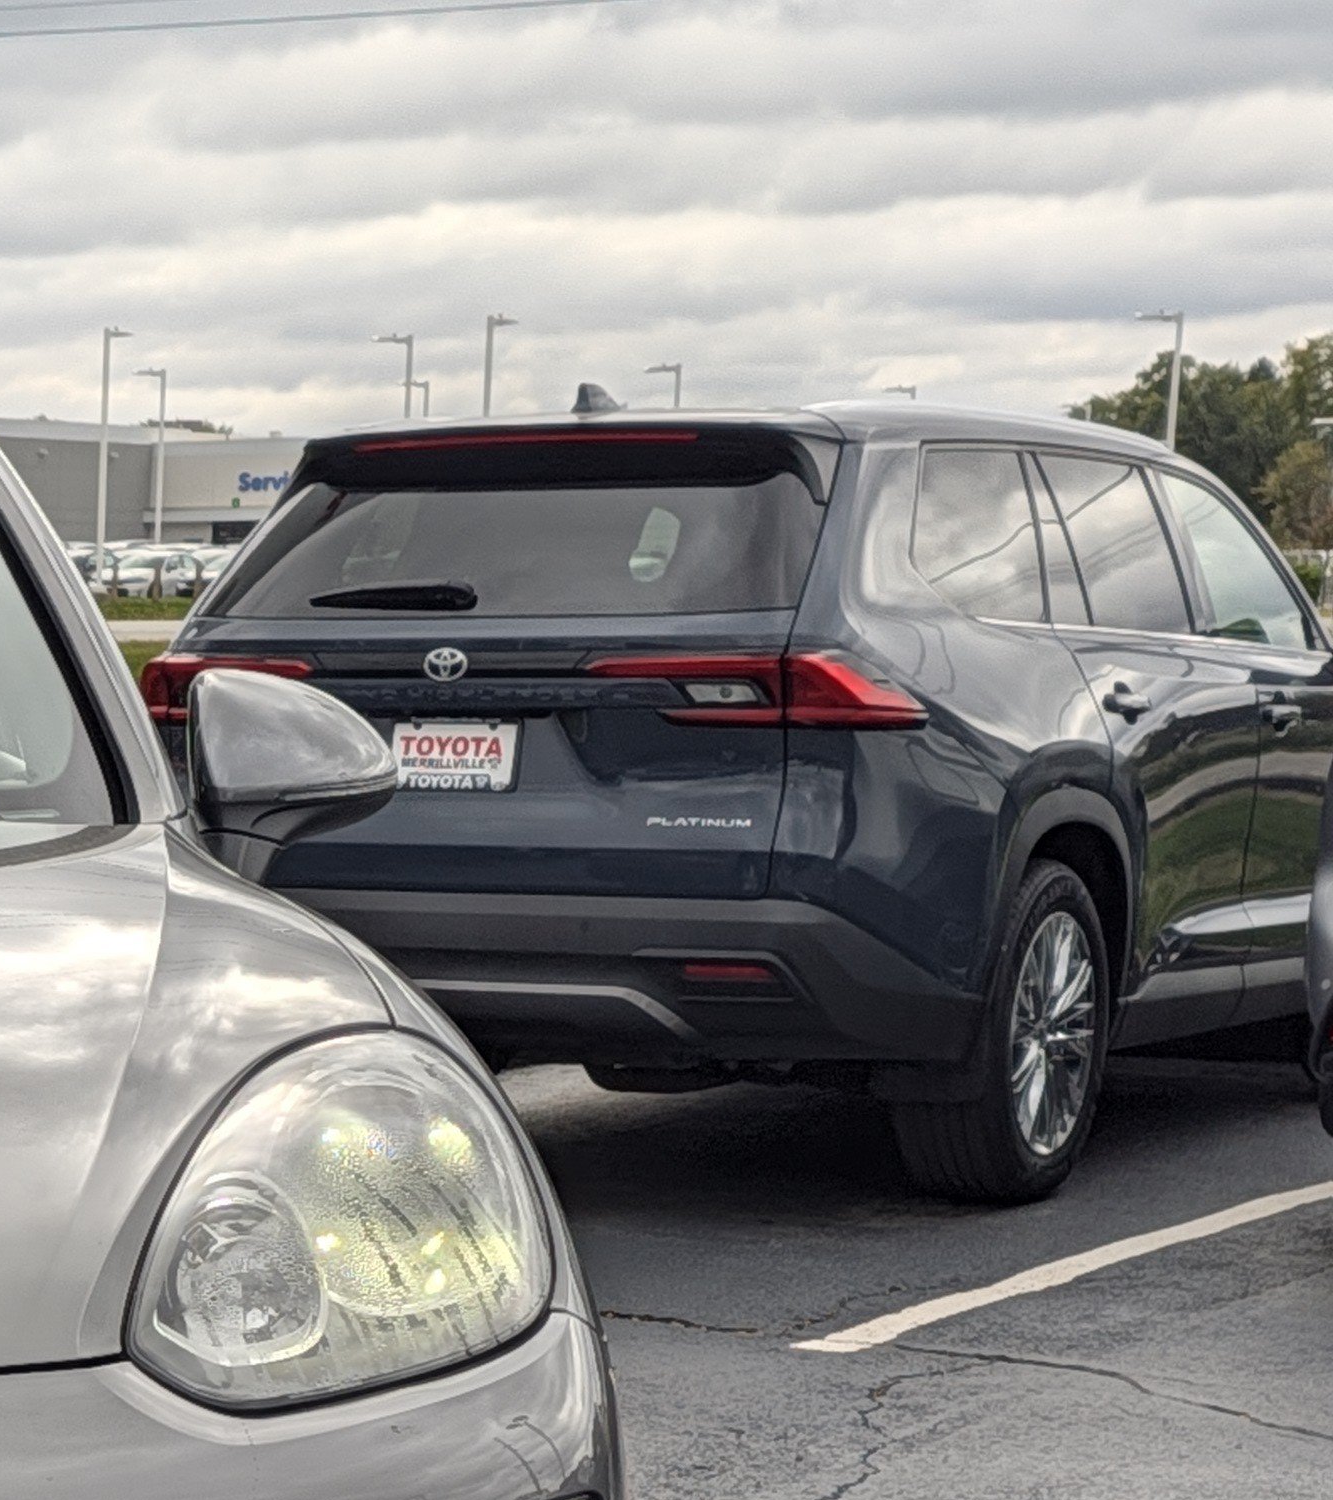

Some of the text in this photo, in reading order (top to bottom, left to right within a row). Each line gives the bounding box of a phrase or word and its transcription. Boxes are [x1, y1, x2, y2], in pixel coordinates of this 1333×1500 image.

[400, 735, 503, 757] TOYOTA
[408, 774, 474, 790] TOYOTA
[646, 816, 752, 828] PLATINUM
